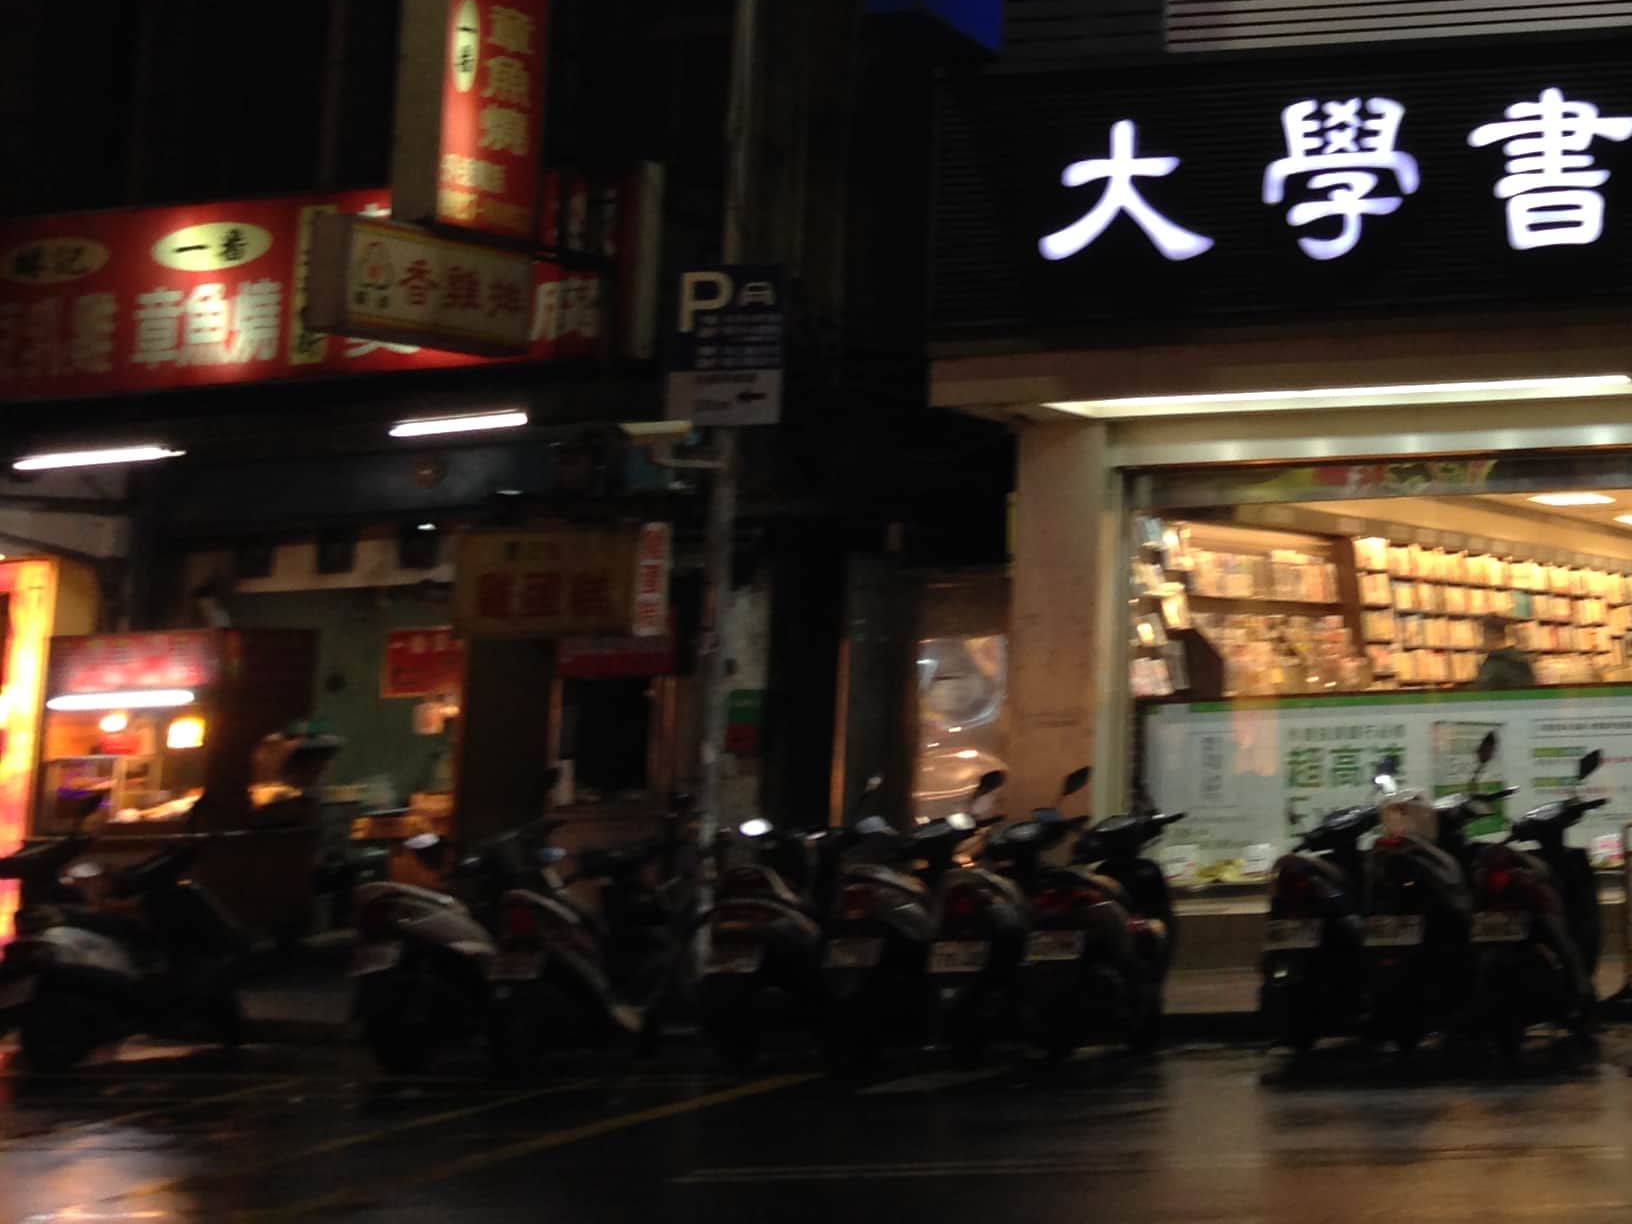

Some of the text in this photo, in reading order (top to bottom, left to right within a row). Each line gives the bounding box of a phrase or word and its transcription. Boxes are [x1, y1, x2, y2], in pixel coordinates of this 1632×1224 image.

[131, 278, 283, 369] 章魚燒
[676, 270, 735, 334] P
